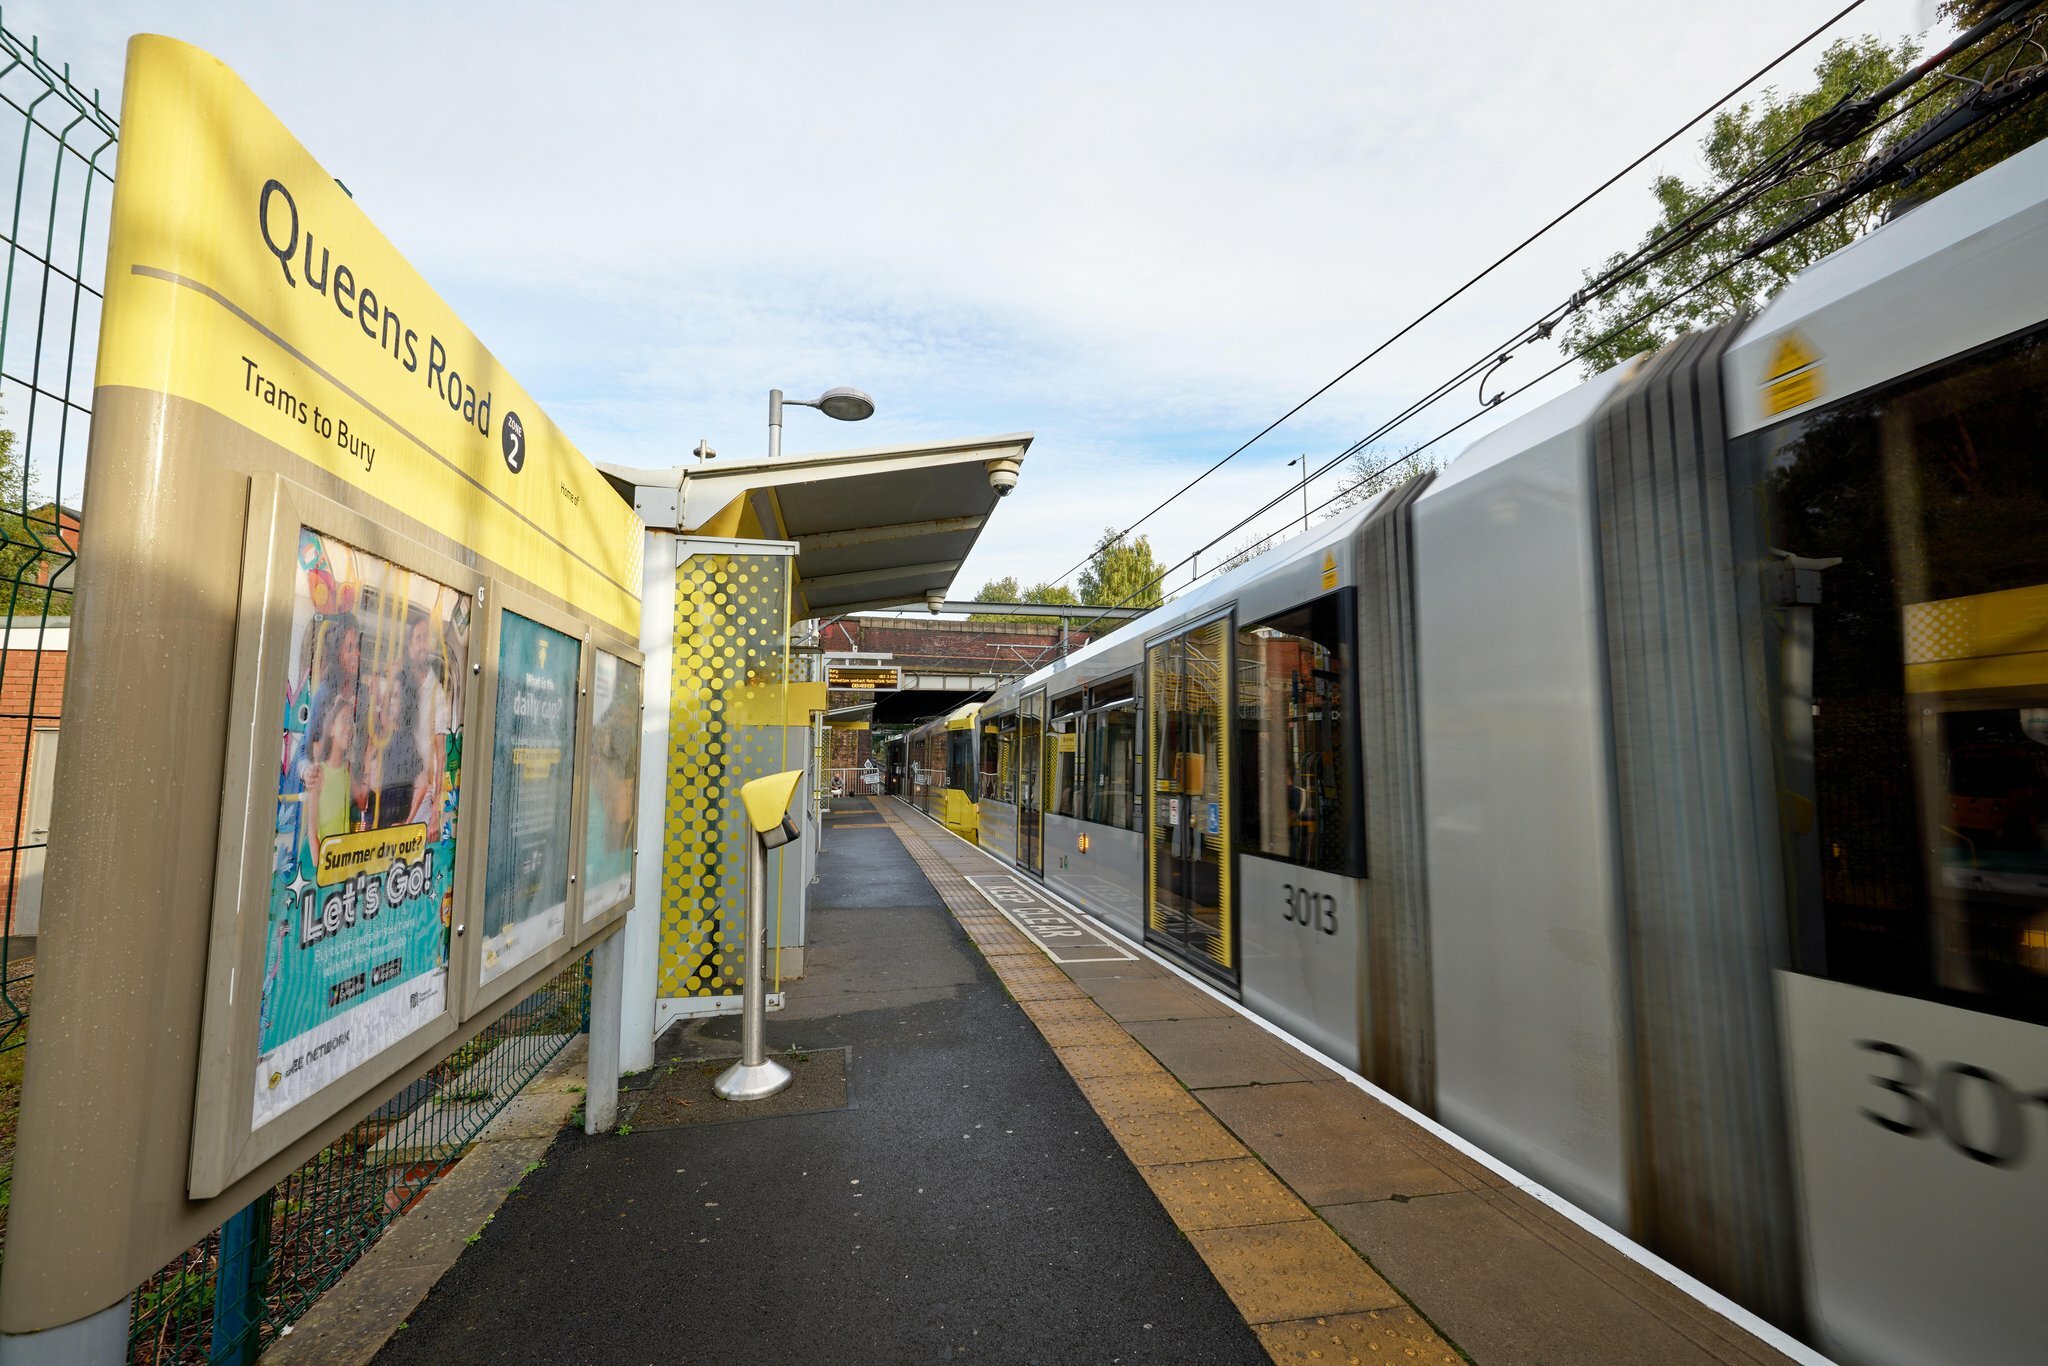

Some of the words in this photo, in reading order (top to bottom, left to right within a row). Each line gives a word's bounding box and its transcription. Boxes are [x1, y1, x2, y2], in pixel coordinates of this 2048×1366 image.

[259, 178, 418, 373] Queens
[427, 335, 492, 438] Road
[241, 355, 308, 426] Trams
[313, 406, 332, 439] to
[337, 419, 376, 472] Bury
[508, 416, 522, 438] ZONE
[507, 433, 519, 469] 2
[513, 690, 538, 724] daily
[324, 847, 376, 871] Summer
[377, 842, 397, 861] day
[399, 836, 423, 855] out?
[301, 872, 381, 946] Let's
[386, 851, 433, 905] Go!
[1281, 884, 1339, 936] 3013
[1012, 907, 1083, 938] CLEAR
